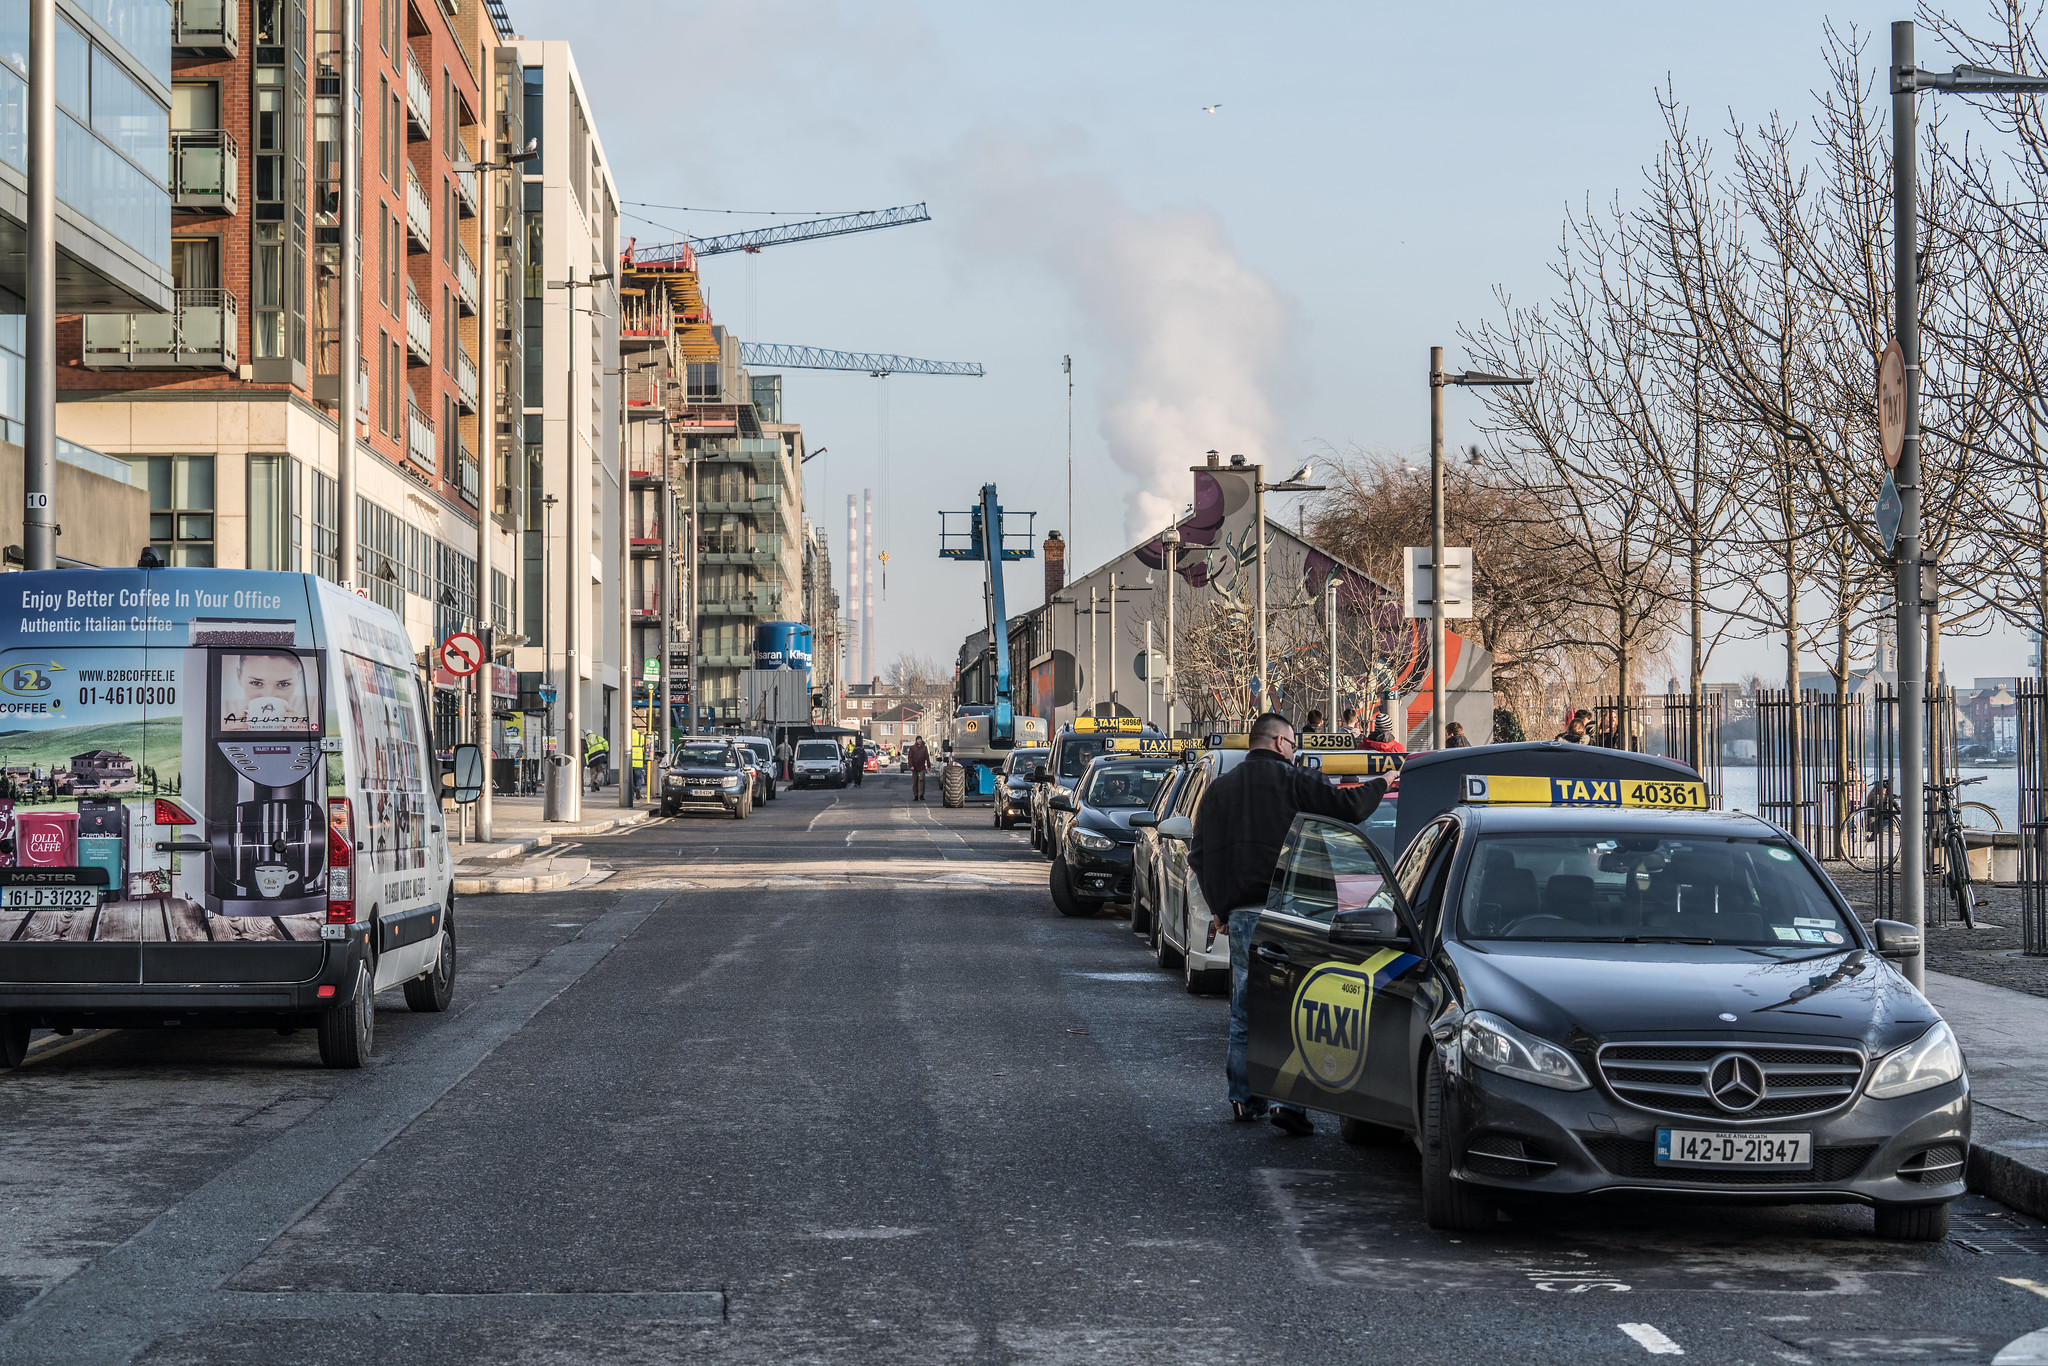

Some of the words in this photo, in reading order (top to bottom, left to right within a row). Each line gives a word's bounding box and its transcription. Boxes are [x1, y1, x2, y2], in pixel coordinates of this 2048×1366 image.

[1882, 392, 1902, 430] TAXI
[28, 494, 47, 507] 10
[22, 590, 62, 612] Enjoy
[67, 589, 114, 608] Better
[119, 588, 170, 608] Coffee
[175, 589, 189, 607] In
[195, 589, 229, 608] Your
[234, 590, 281, 609] Office
[20, 617, 81, 633] Authentic
[85, 616, 126, 632] Italian
[130, 616, 173, 632] Coffee
[13, 669, 52, 691] b2b
[78, 669, 176, 682] WWW.B2BCOFFEE.IE
[79, 686, 176, 706] 01-4610300
[0, 702, 48, 714] COFFEE
[1098, 718, 1119, 727] TAXI
[1122, 718, 1141, 726] 50960
[1106, 739, 1115, 749] D
[1142, 739, 1171, 751] TAXI
[1211, 734, 1222, 746] D
[1310, 734, 1352, 747] 32598
[1187, 751, 1196, 761] D
[1307, 756, 1321, 771] D
[1468, 777, 1487, 797] D
[1555, 779, 1618, 802] TAXI
[1631, 783, 1699, 806] 40361
[31, 833, 60, 844] JOLLY
[30, 840, 62, 852] CAFFÈ
[11, 873, 77, 882] MASTER
[8, 889, 91, 906] 161-D-31232
[1341, 982, 1361, 995] 40361
[1302, 998, 1360, 1051] TAXI
[1657, 1147, 1669, 1156] IRL
[1680, 1136, 1800, 1163] 142-D-21347
